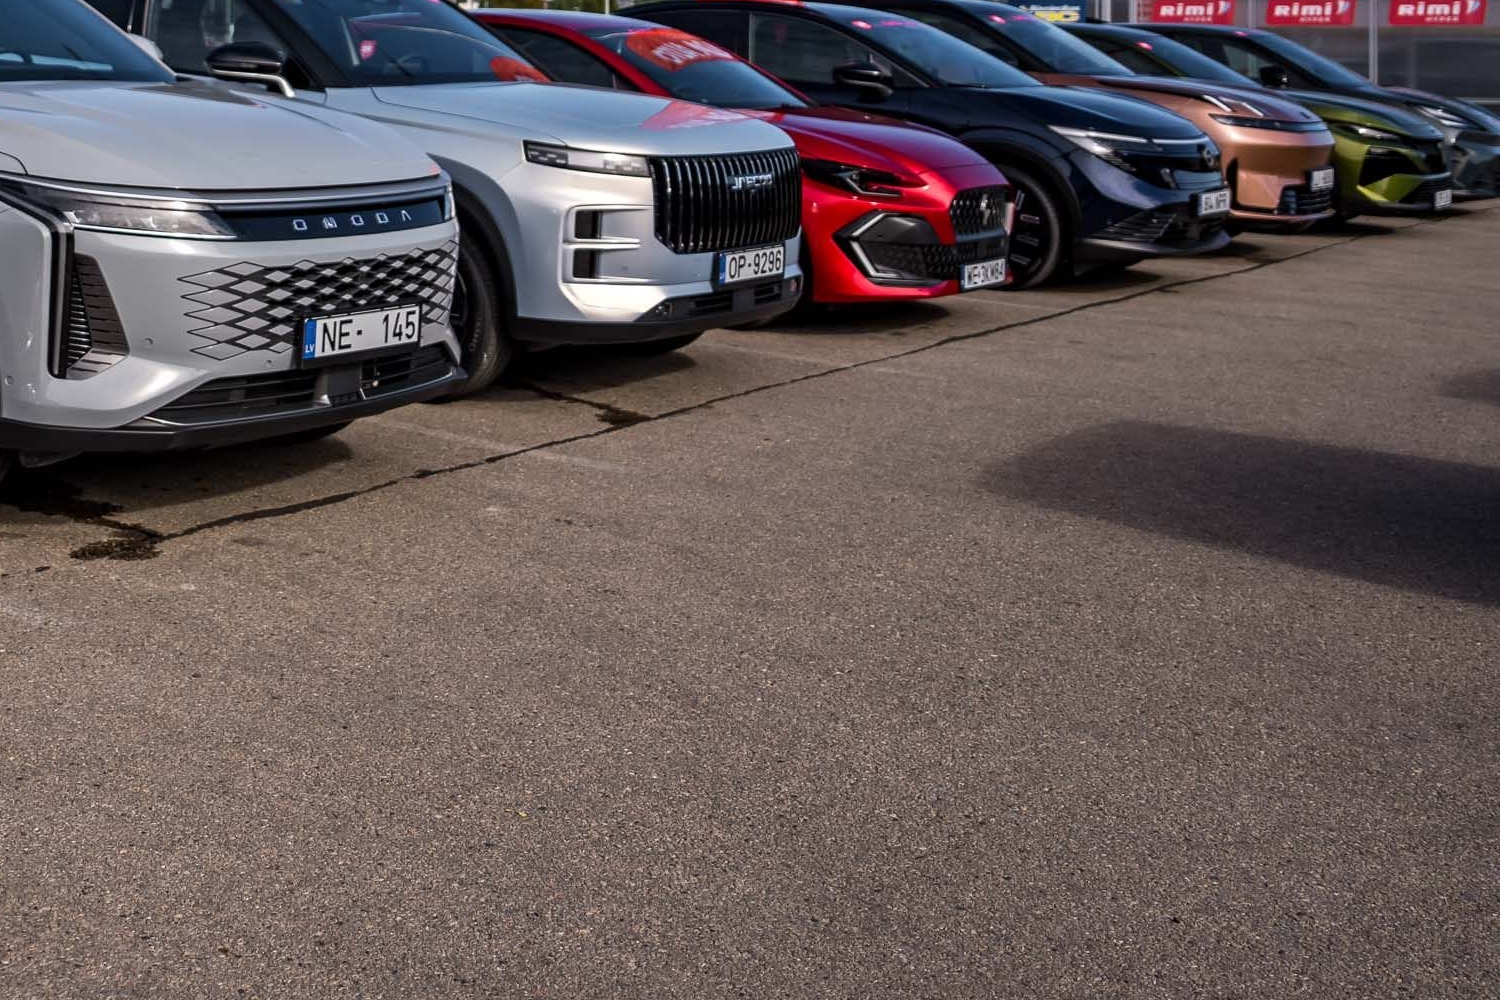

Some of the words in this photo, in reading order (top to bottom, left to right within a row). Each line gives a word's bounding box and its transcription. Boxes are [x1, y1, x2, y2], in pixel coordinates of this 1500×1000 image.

[1397, 1, 1461, 16] Rimi
[729, 250, 782, 279] OP-9296
[382, 309, 417, 344] 145
[305, 343, 315, 353] LV
